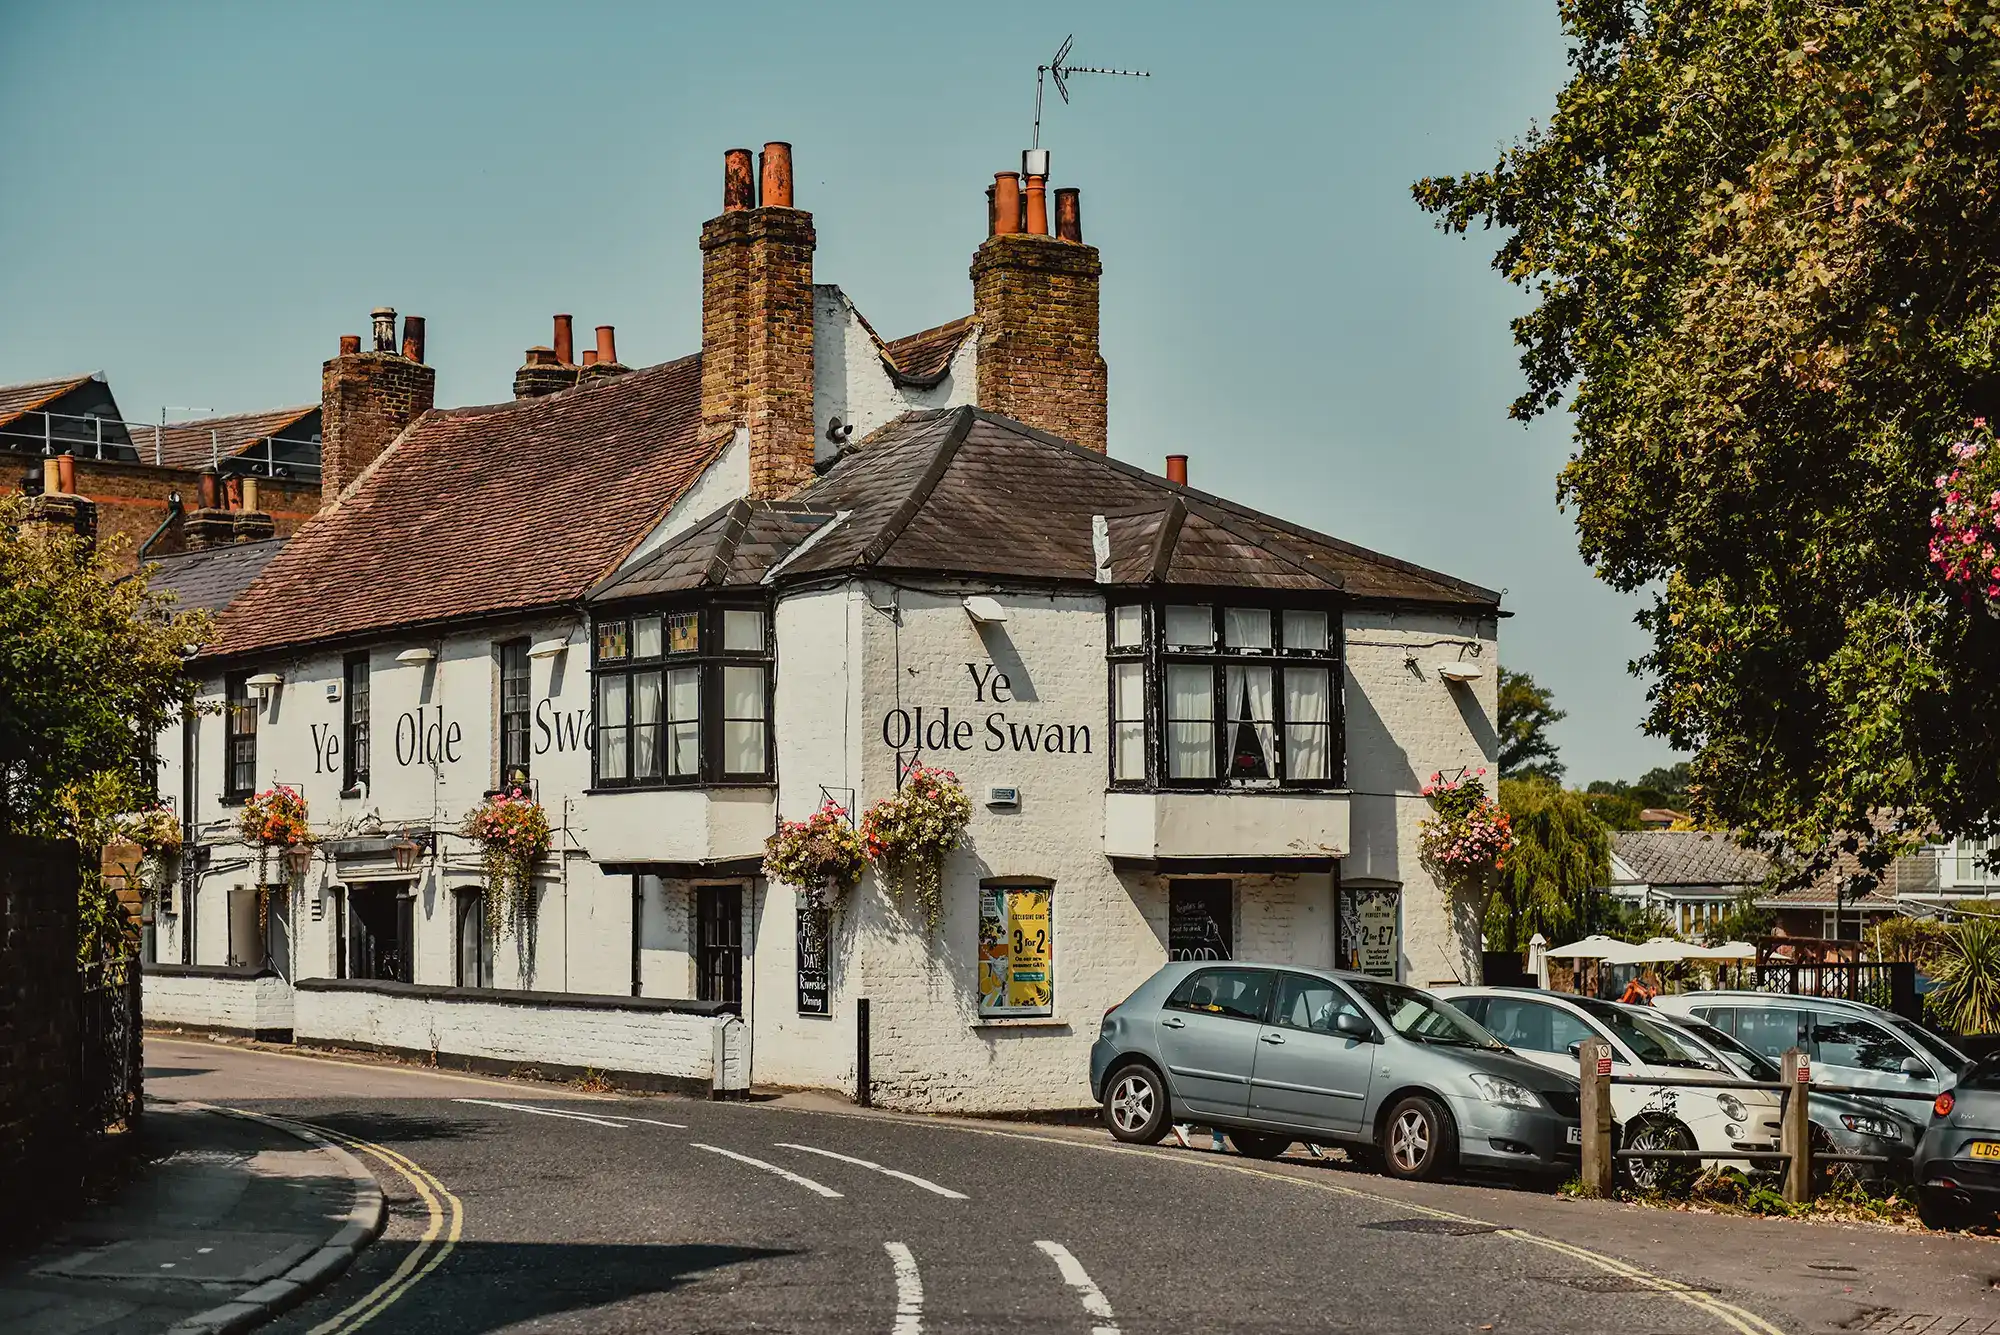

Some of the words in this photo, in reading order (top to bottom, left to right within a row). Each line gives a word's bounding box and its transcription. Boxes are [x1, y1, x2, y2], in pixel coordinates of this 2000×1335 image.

[965, 662, 1011, 702] Ye
[310, 722, 339, 774] Ye
[395, 704, 462, 767] Olde
[882, 706, 973, 751] Olde
[984, 712, 1093, 754] Swan
[1013, 929, 1023, 954] 3
[1024, 938, 1036, 947] for
[1036, 929, 1045, 954] 2
[1362, 926, 1369, 946] 2
[1379, 926, 1393, 946] £7
[804, 953, 819, 968] DAY
[799, 973, 826, 991] Riverside
[802, 992, 822, 1012] Dining
[1976, 1144, 2000, 1156] LD6
